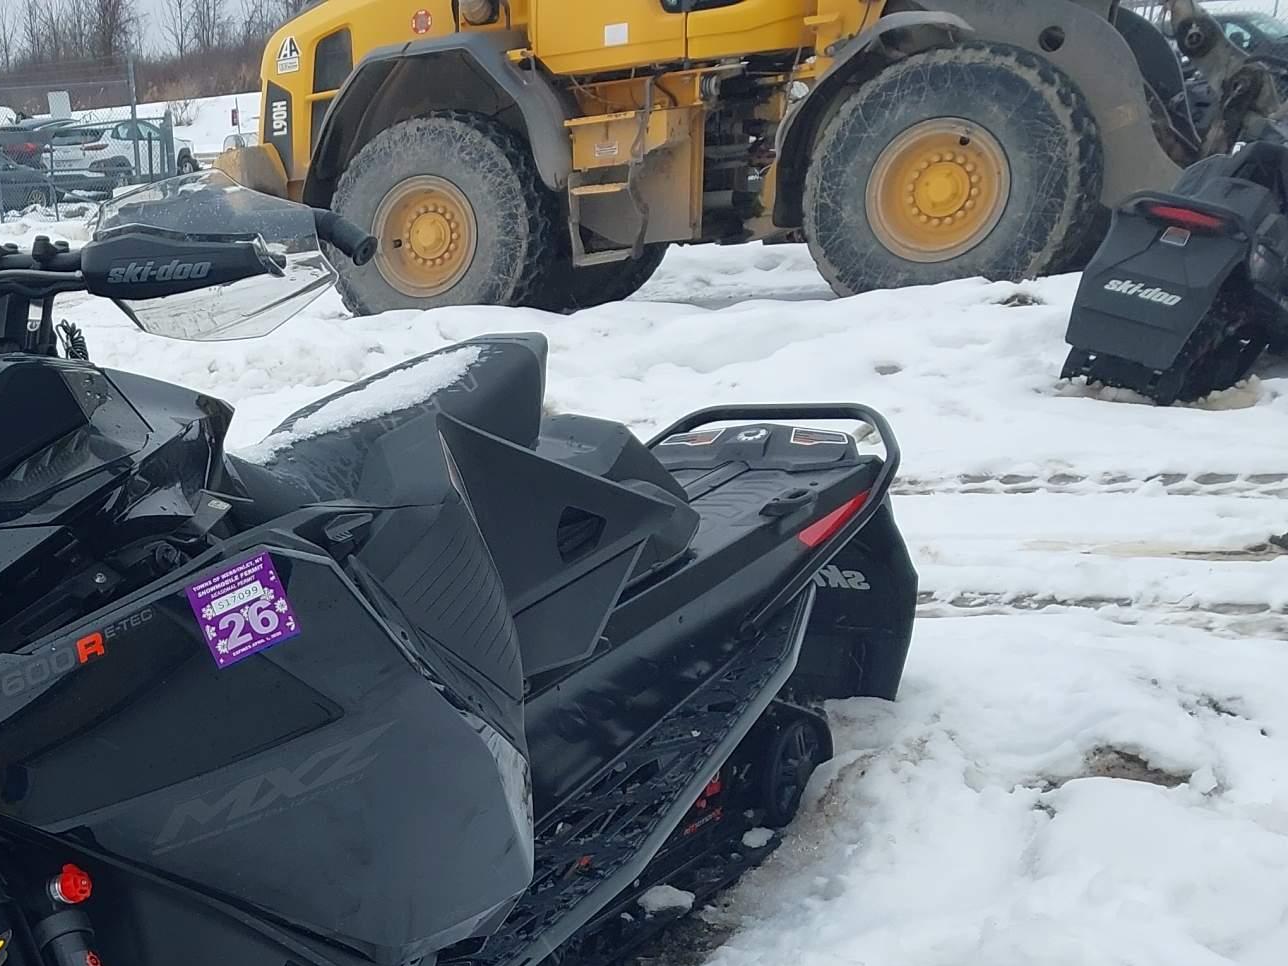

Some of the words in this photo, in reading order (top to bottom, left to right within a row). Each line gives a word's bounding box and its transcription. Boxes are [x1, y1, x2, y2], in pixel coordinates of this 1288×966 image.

[272, 100, 287, 136] L90H
[107, 260, 211, 283] ski-doo
[1104, 279, 1183, 306] ski-doo
[197, 574, 239, 598] SNOWMOBILE
[240, 564, 263, 578] PERMIT
[218, 586, 258, 610] S17099
[219, 600, 279, 651] 26
